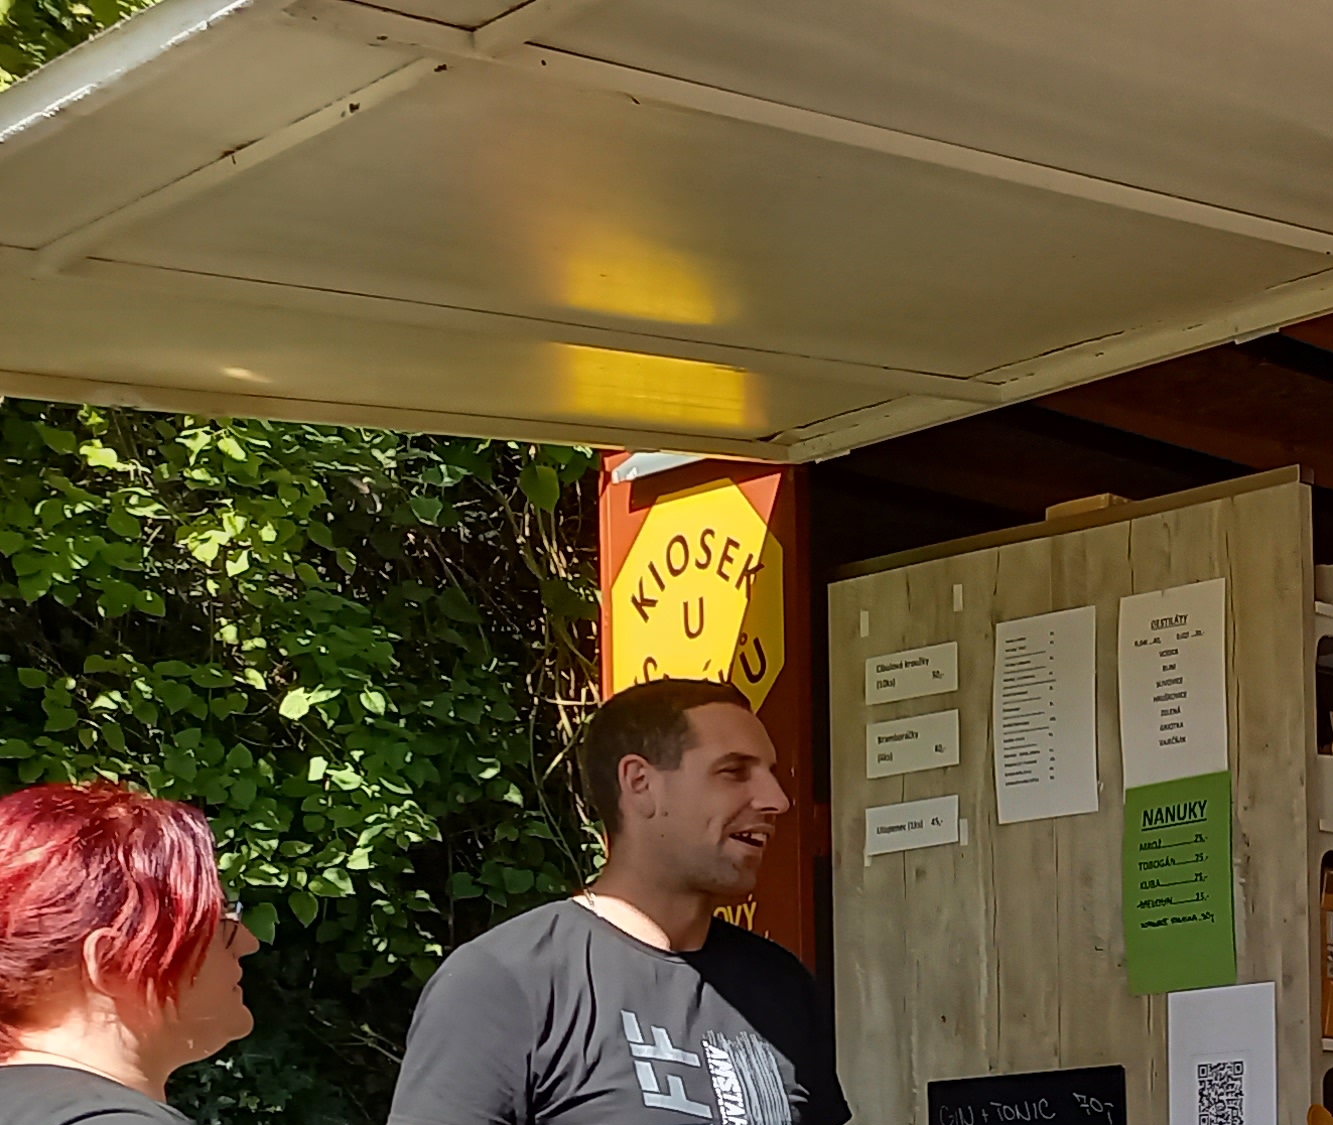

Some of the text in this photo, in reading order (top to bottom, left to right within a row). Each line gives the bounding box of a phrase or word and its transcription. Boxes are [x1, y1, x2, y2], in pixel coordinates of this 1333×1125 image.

[631, 528, 766, 624] KIOSEK
[683, 596, 704, 640] U
[1142, 800, 1208, 828] NANUKY
[989, 1098, 1056, 1122] TONIC
